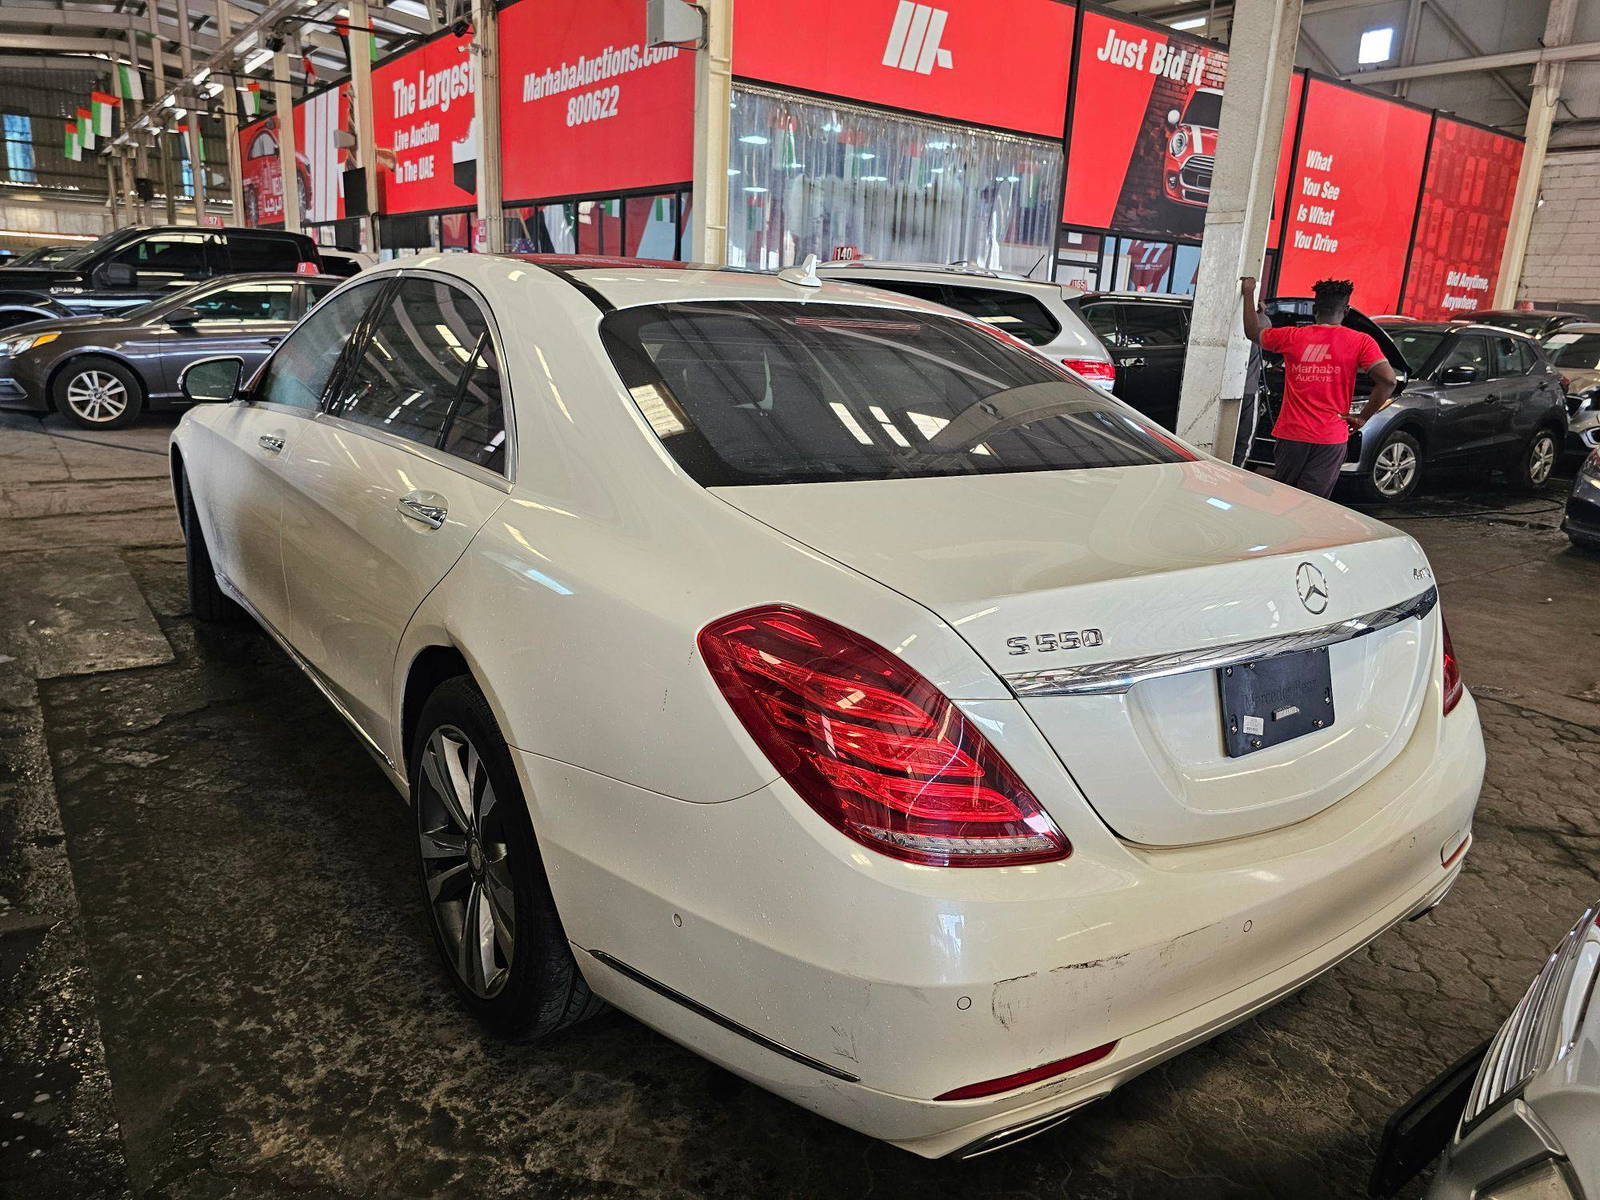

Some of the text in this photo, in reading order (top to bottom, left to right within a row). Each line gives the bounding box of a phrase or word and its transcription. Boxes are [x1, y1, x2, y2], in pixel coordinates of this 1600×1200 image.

[1096, 28, 1207, 87] Just Bid It
[523, 43, 680, 103] MarhabaAuctions.com
[393, 61, 476, 119] The Largest
[566, 85, 620, 127] 800622
[394, 120, 440, 152] Live Auction
[395, 155, 435, 184] In The UAE
[1305, 149, 1333, 172] What
[1302, 177, 1341, 201] You See
[1296, 203, 1335, 227] Is What
[837, 247, 853, 261] 140
[1141, 243, 1168, 264] 77
[1293, 230, 1339, 254] You Drive
[1446, 271, 1462, 287] Bid
[1441, 293, 1478, 311] Anywhere
[1291, 363, 1342, 374] Marhaba
[1006, 628, 1104, 656] S 550
